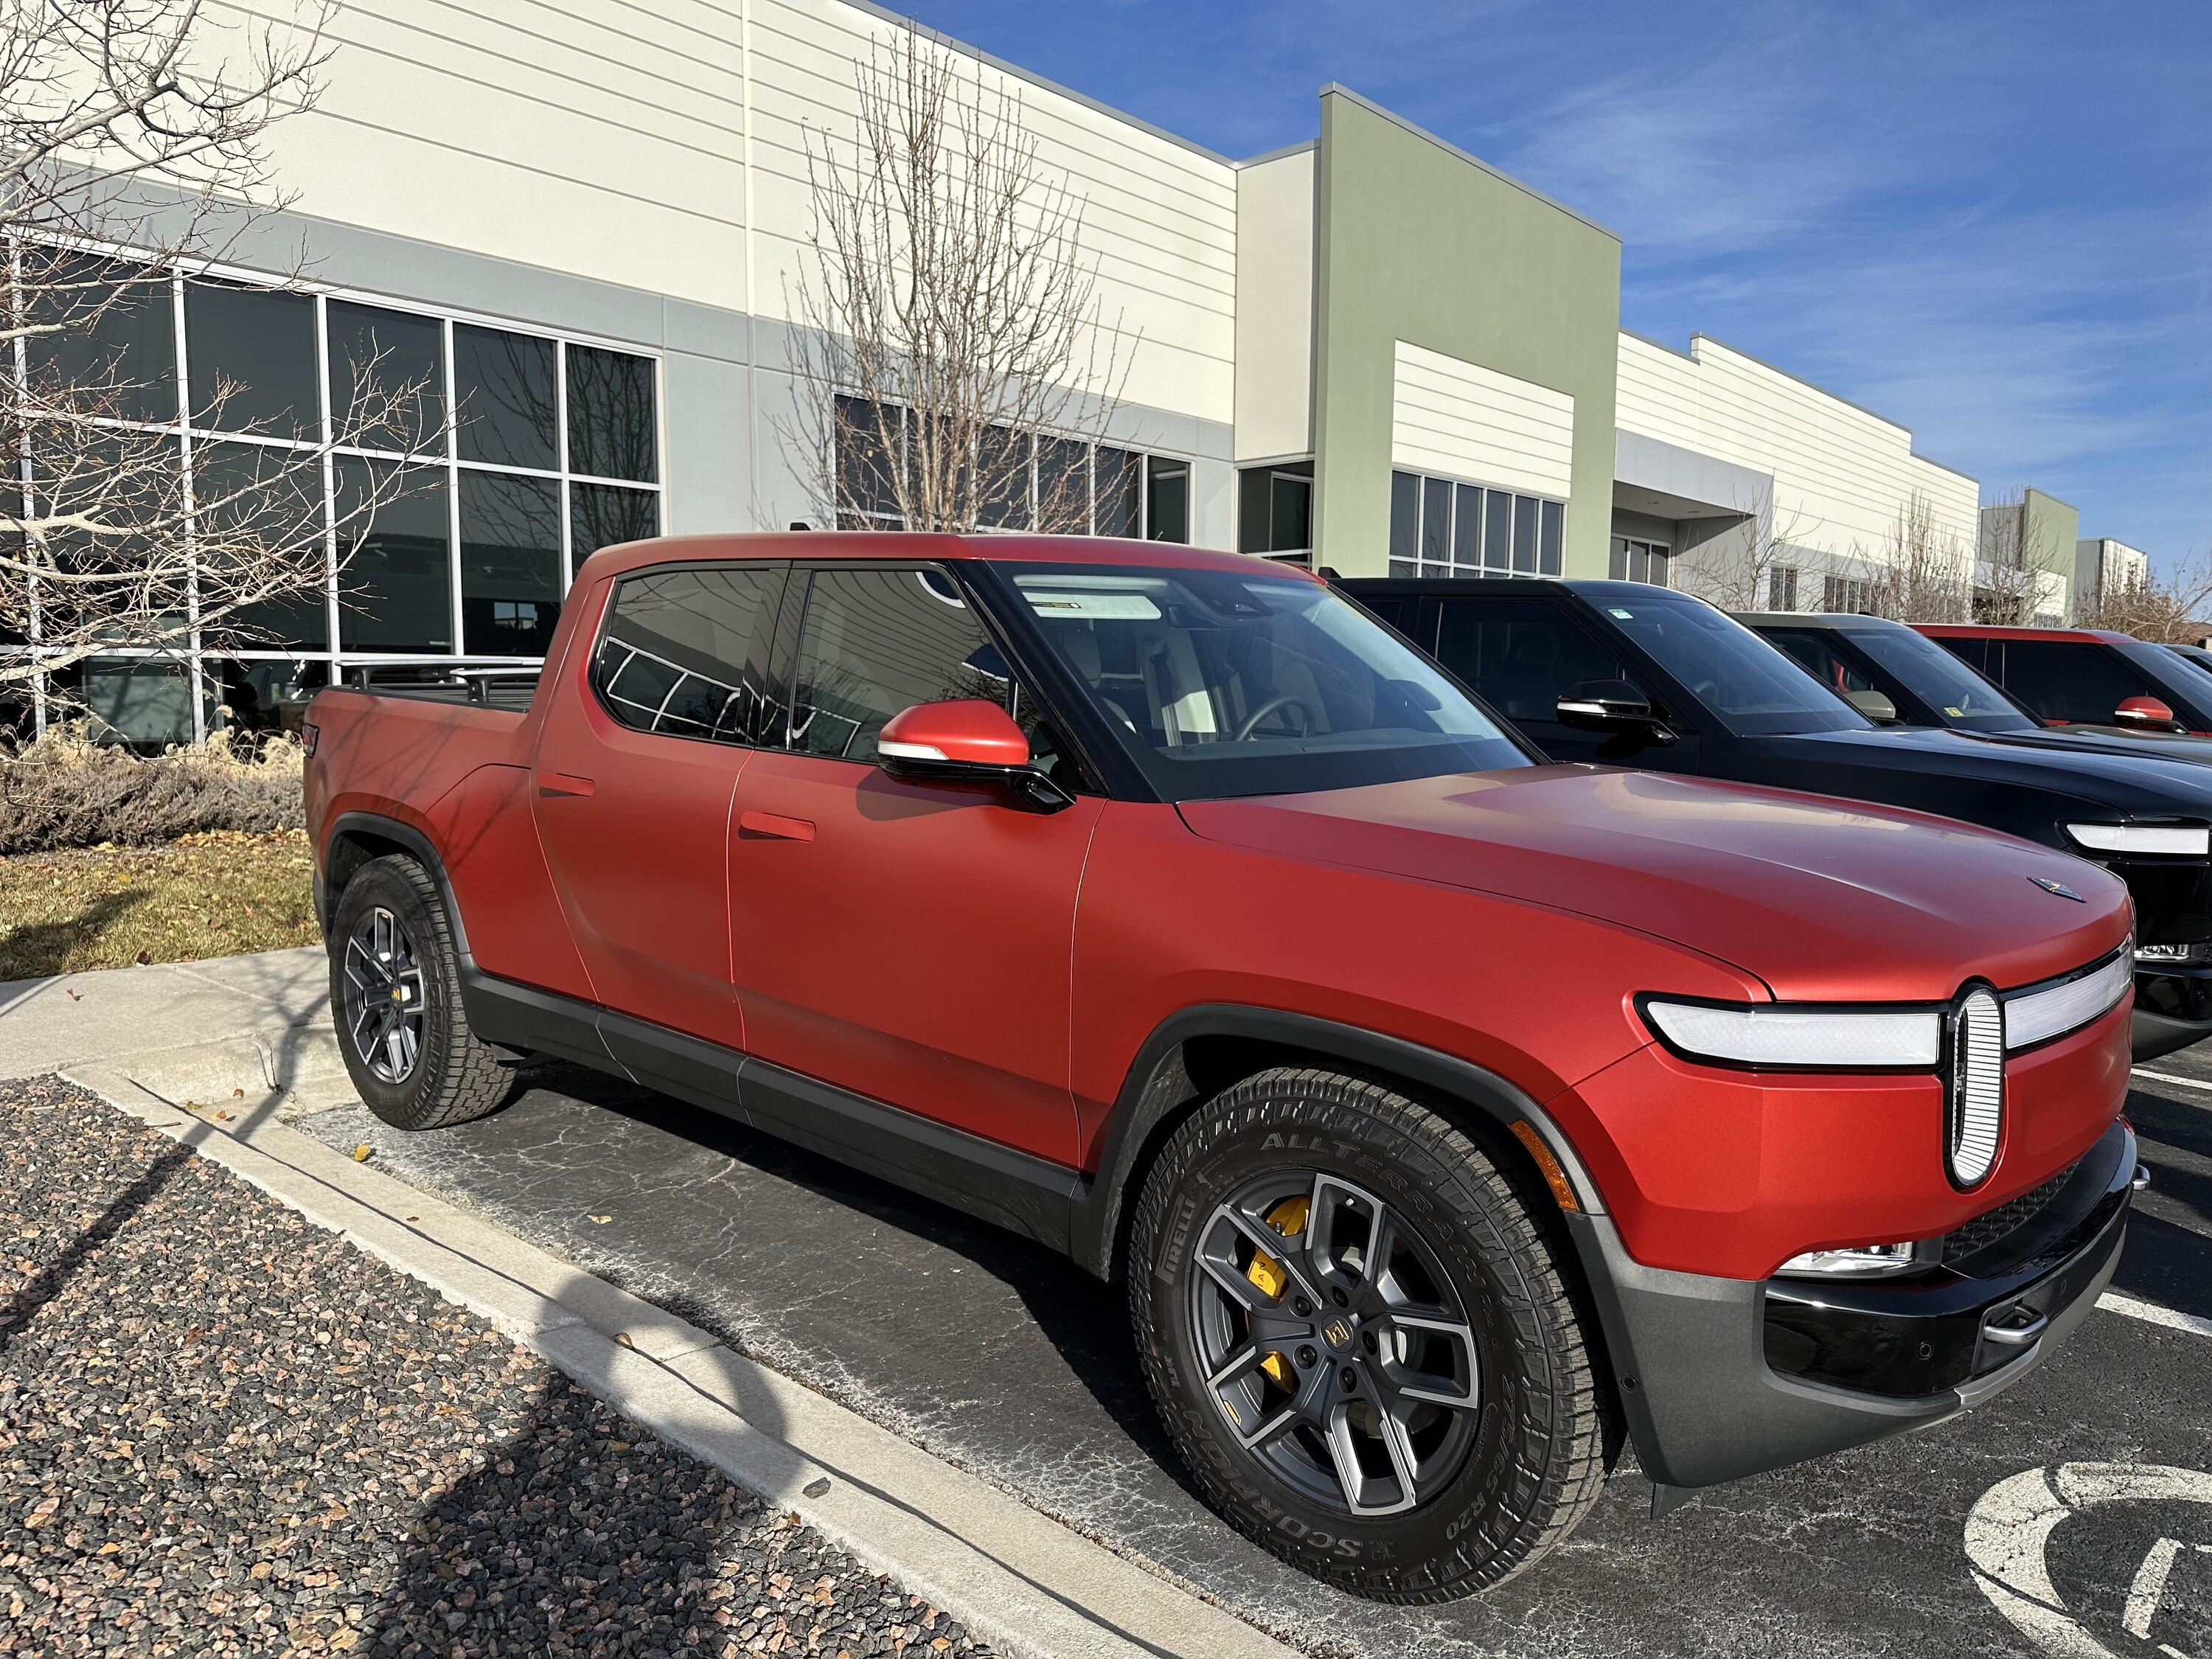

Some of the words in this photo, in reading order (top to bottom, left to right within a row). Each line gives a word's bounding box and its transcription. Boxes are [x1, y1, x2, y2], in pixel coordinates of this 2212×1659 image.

[1154, 1192, 1197, 1287] PIRELLI
[1256, 1261, 1267, 1287] IAN
[1486, 1373, 1516, 1495] 275/65
[1183, 1409, 1363, 1558] SCORPION
[1446, 1490, 1486, 1540] R20
